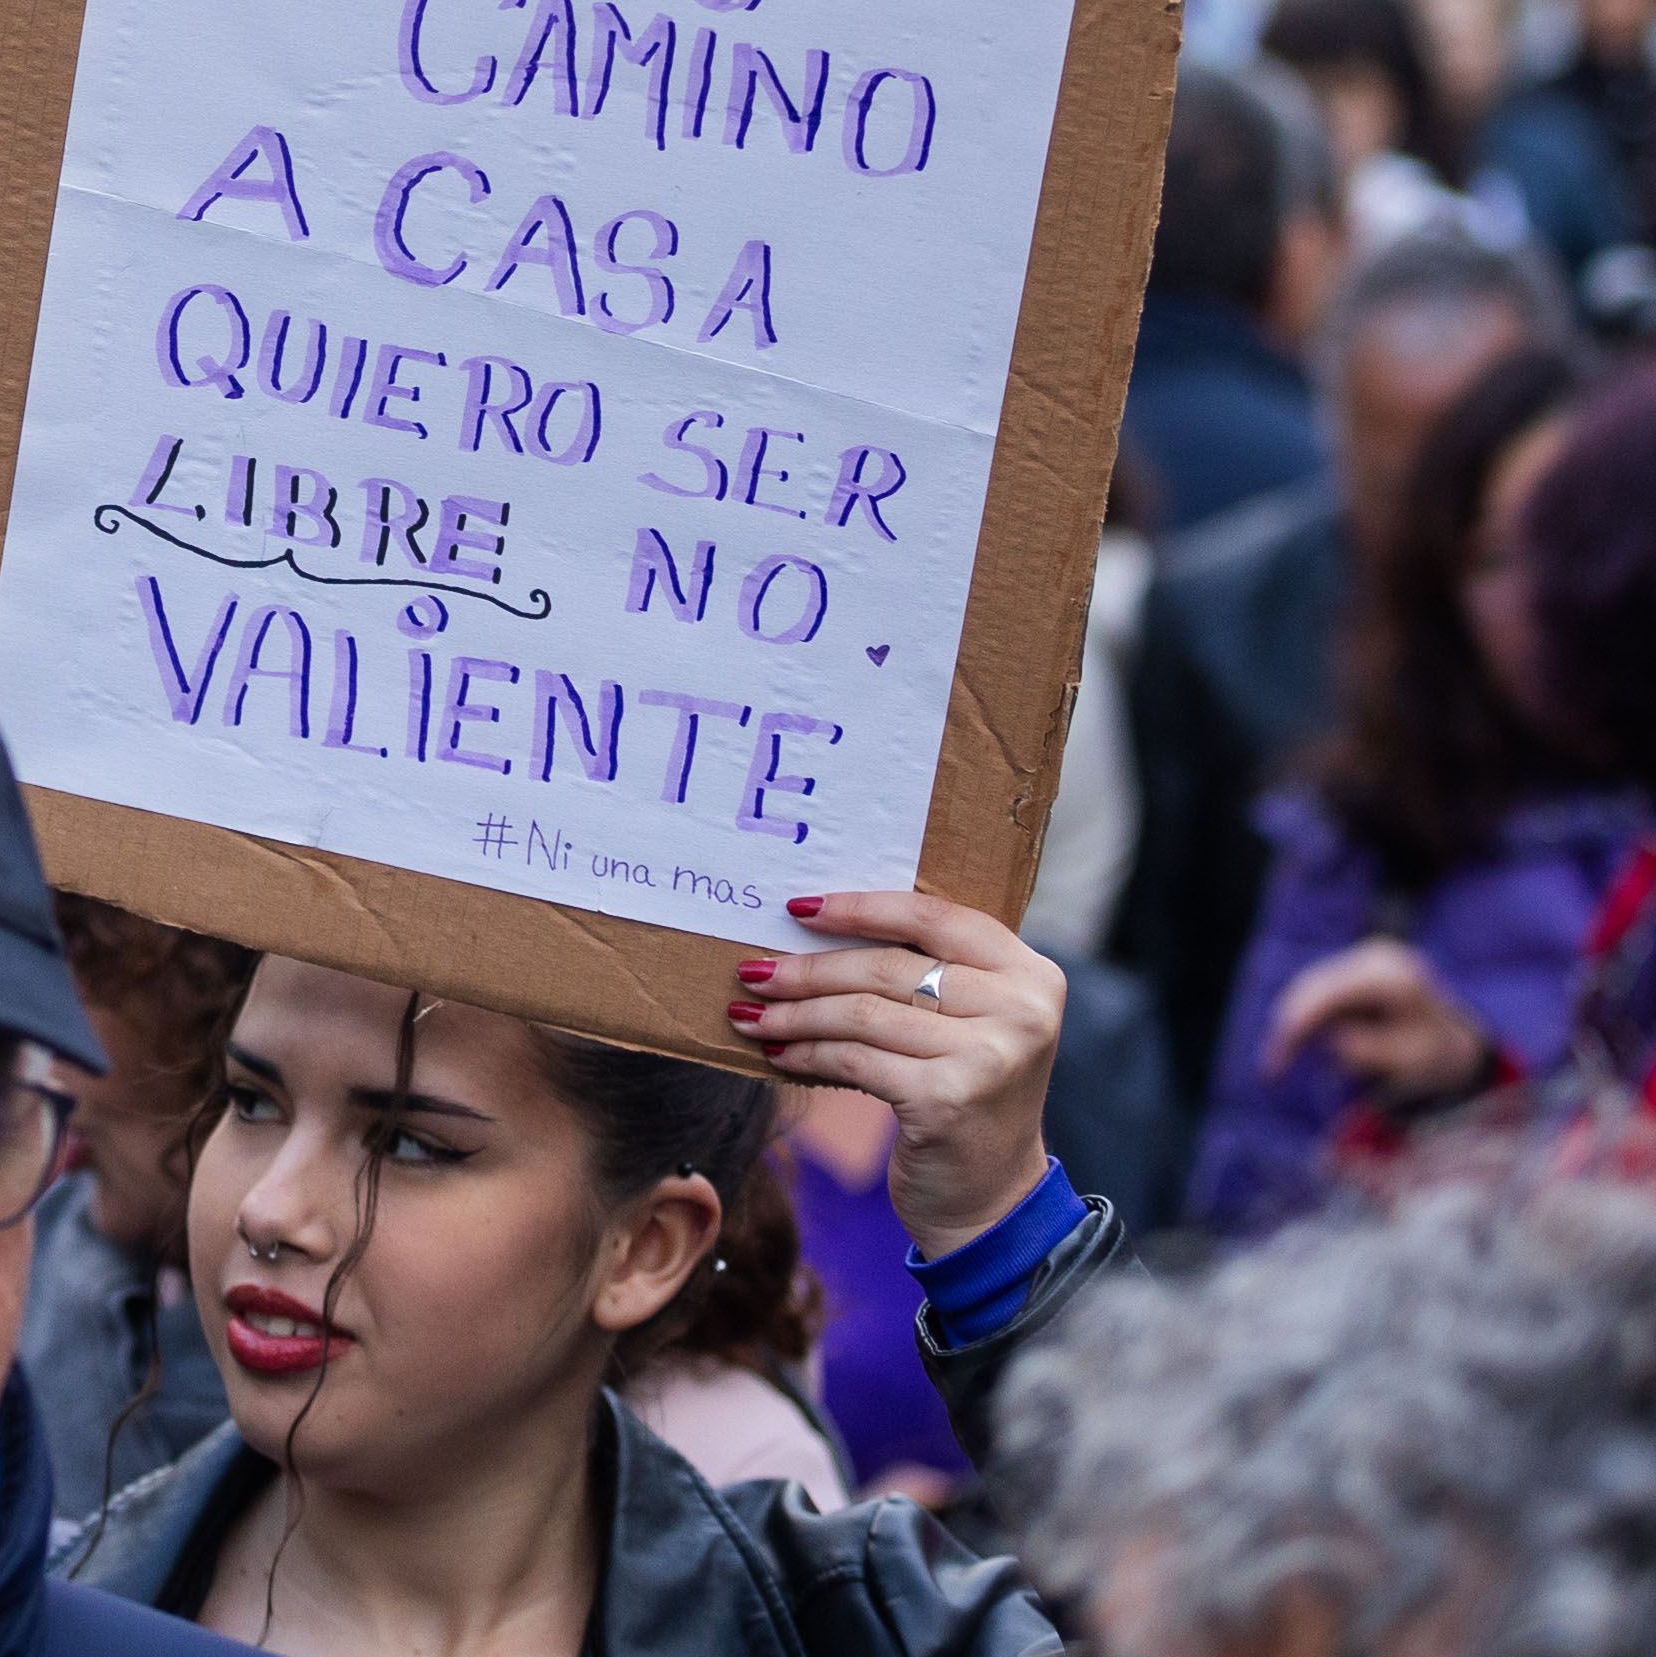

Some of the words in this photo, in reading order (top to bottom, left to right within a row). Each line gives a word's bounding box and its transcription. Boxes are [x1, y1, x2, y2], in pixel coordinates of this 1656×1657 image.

[177, 128, 310, 240] A
[376, 153, 779, 349] CASA
[159, 286, 603, 465] QUIERO
[642, 413, 908, 544] SER
[125, 437, 511, 585] LIBRE
[627, 529, 829, 644] NO
[473, 813, 572, 871] #Ni
[592, 855, 656, 887] una
[673, 866, 762, 909] mas
